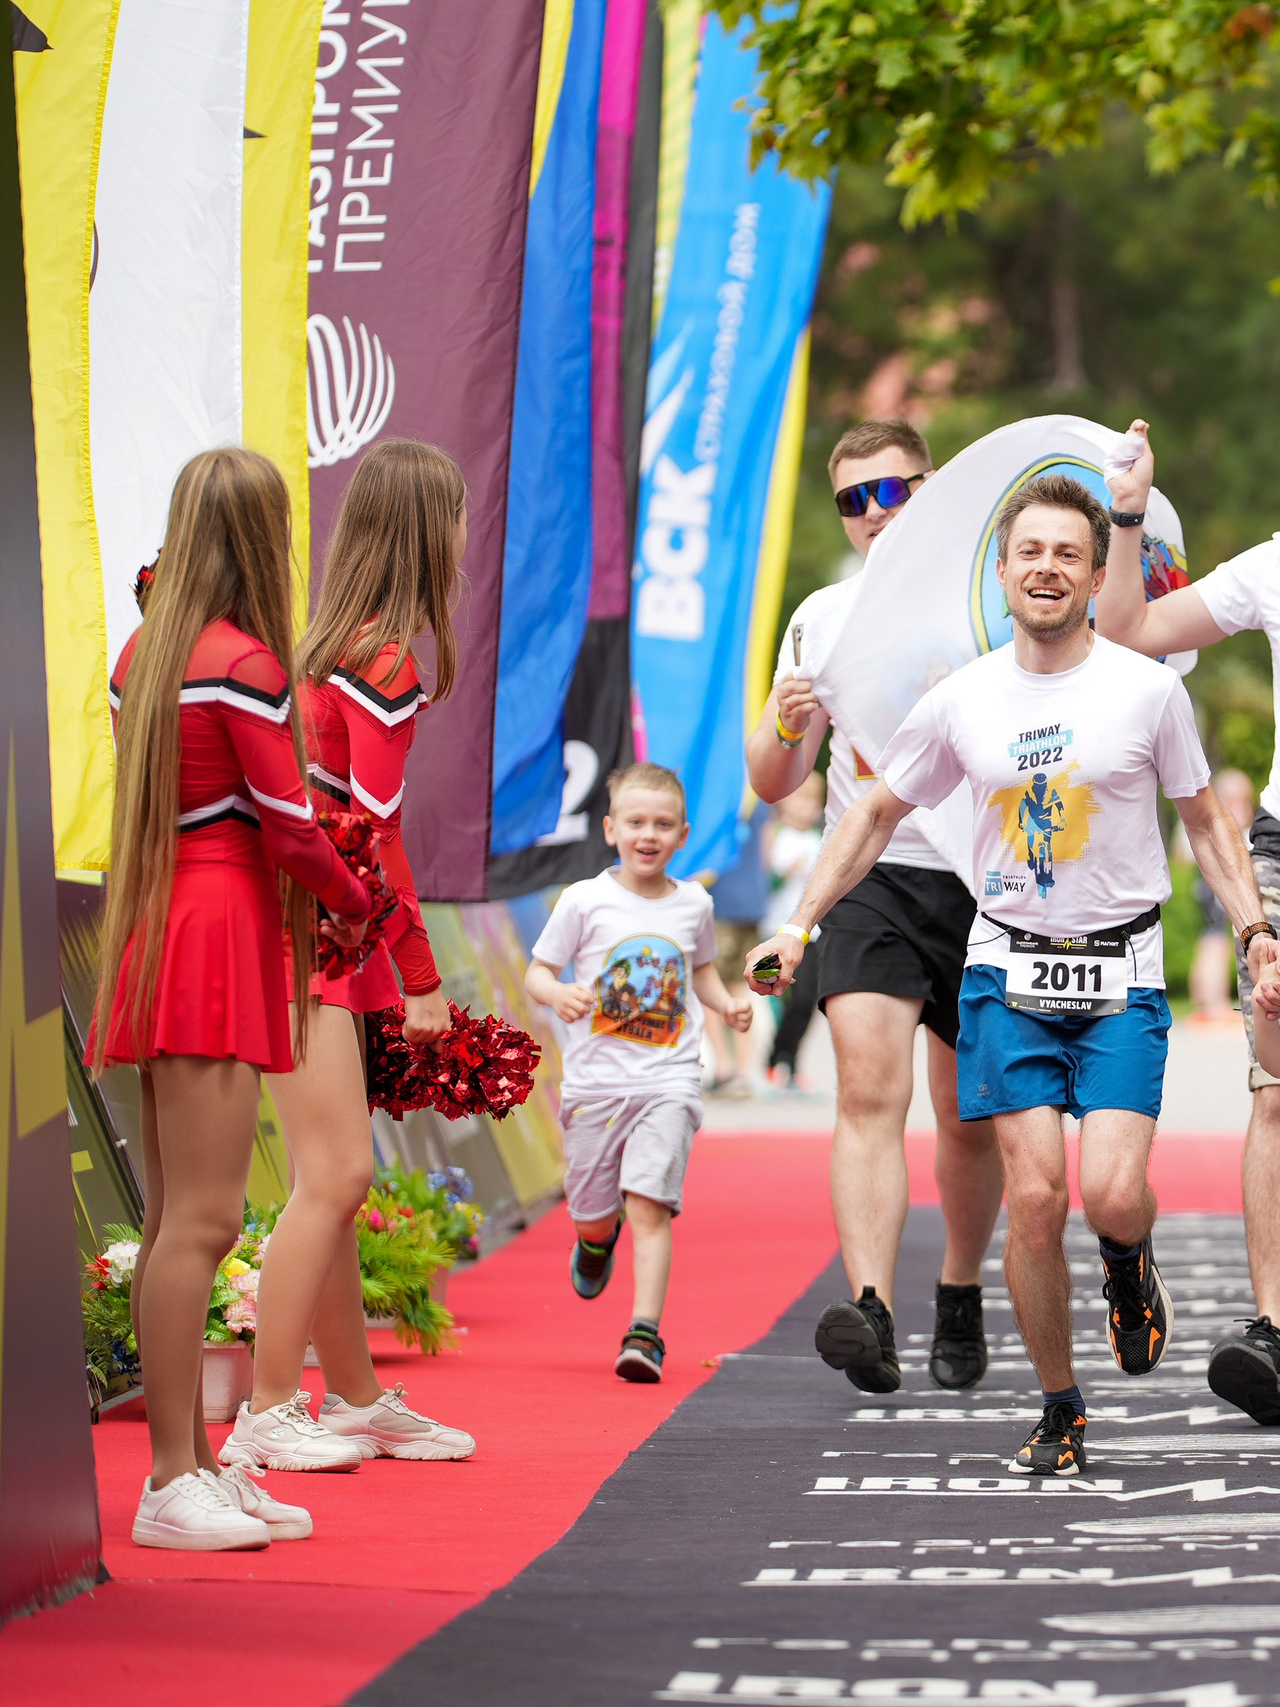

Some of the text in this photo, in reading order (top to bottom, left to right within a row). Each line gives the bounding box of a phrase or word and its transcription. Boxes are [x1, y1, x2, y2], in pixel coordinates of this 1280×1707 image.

[333, 0, 412, 272] ПРЕМИУ
[635, 453, 717, 641] ВСК
[1012, 733, 1067, 756] TRIATHLON
[1018, 723, 1061, 743] TRIWAY
[1017, 746, 1063, 771] 2022
[985, 881, 1026, 893] TRI WAY
[1031, 961, 1102, 992] 2011
[1039, 999, 1092, 1010] VYACHESLAV
[813, 1476, 1123, 1491] IRON
[756, 1567, 1115, 1581] IRON
[666, 1671, 1098, 1698] IRON
